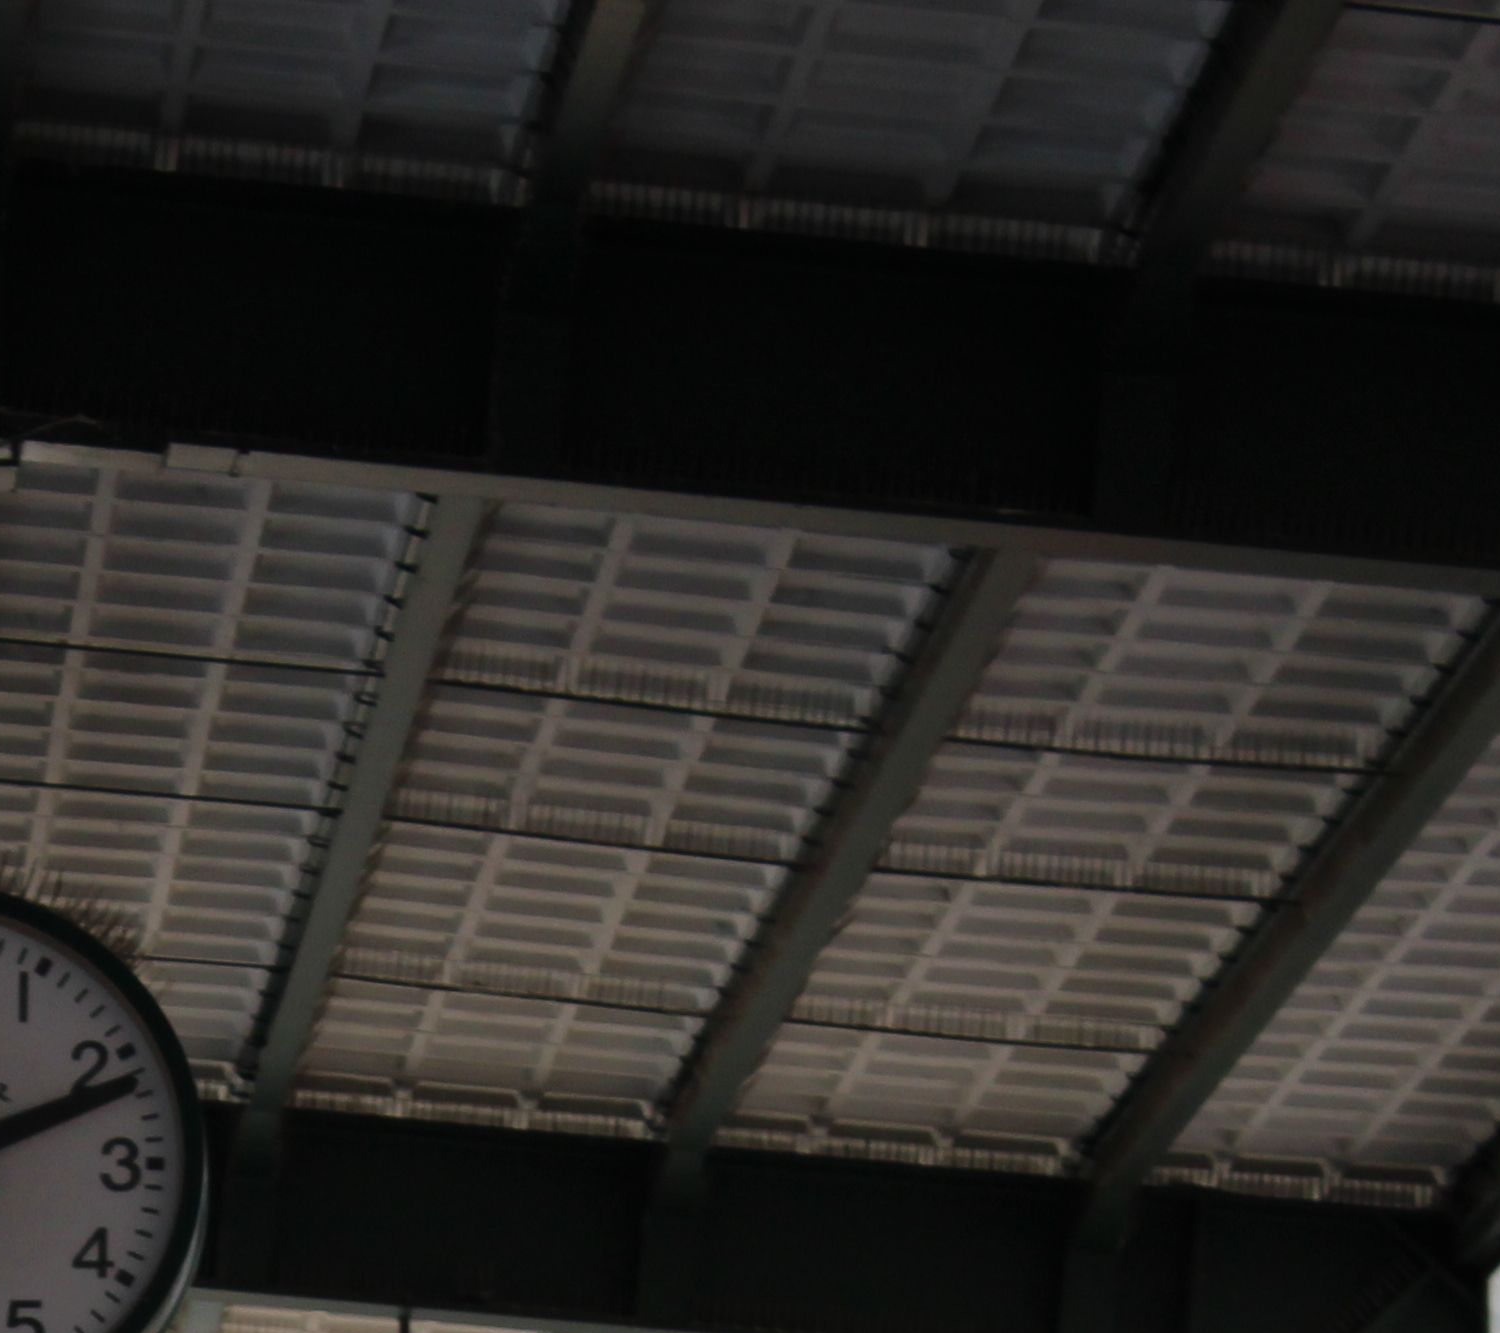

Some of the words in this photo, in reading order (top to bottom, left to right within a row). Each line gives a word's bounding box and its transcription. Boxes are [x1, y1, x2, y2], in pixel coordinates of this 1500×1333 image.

[18, 971, 30, 1023] 1
[71, 1040, 109, 1096] 2
[100, 1136, 142, 1193] 3
[71, 1227, 115, 1280] 4
